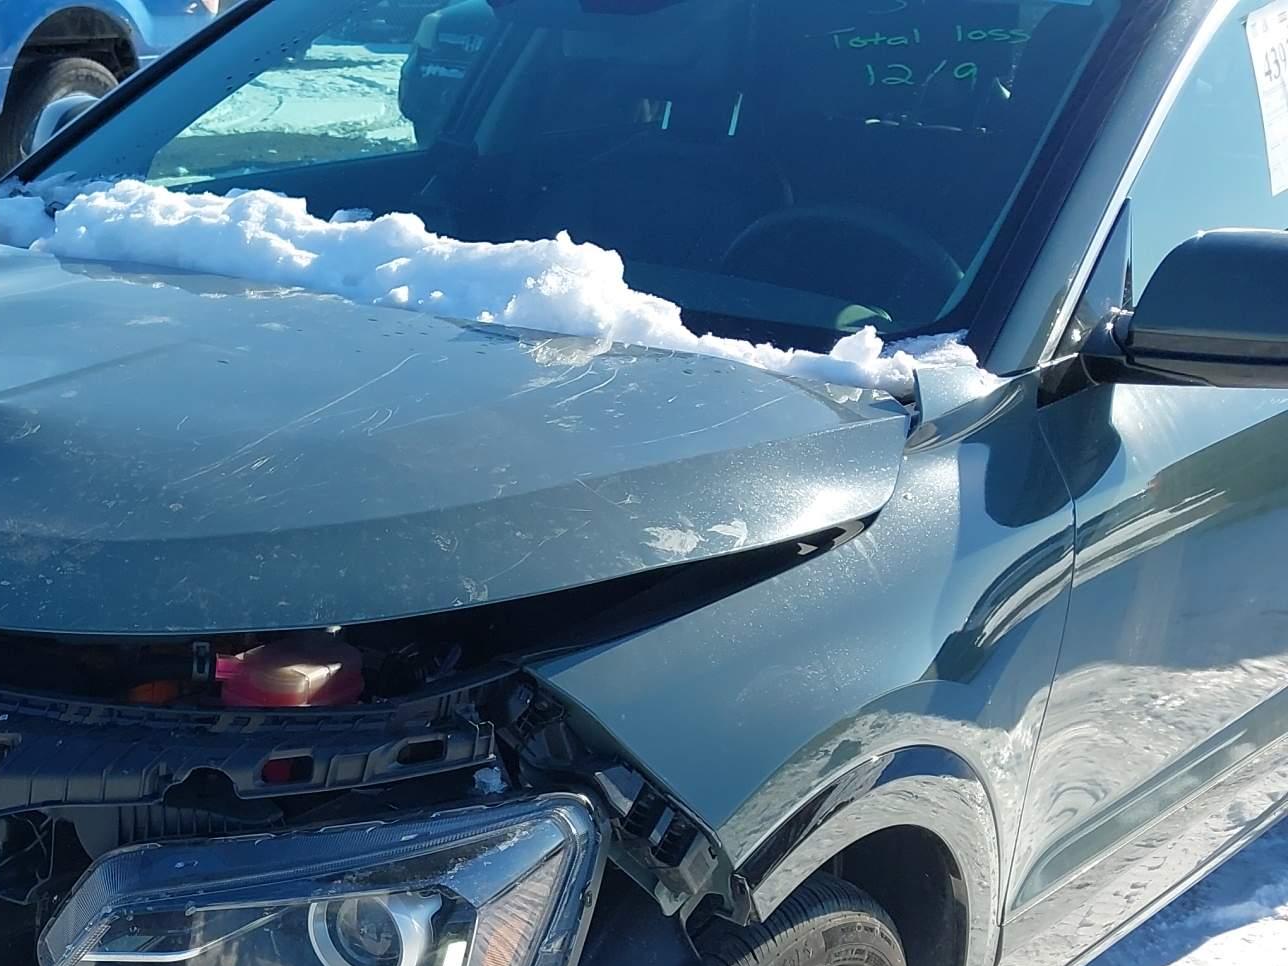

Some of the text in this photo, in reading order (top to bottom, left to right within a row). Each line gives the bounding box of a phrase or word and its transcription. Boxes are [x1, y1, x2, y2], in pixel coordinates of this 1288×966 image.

[828, 25, 1031, 49] Total loss
[1263, 38, 1288, 78] 439
[866, 60, 978, 90] 12/9
